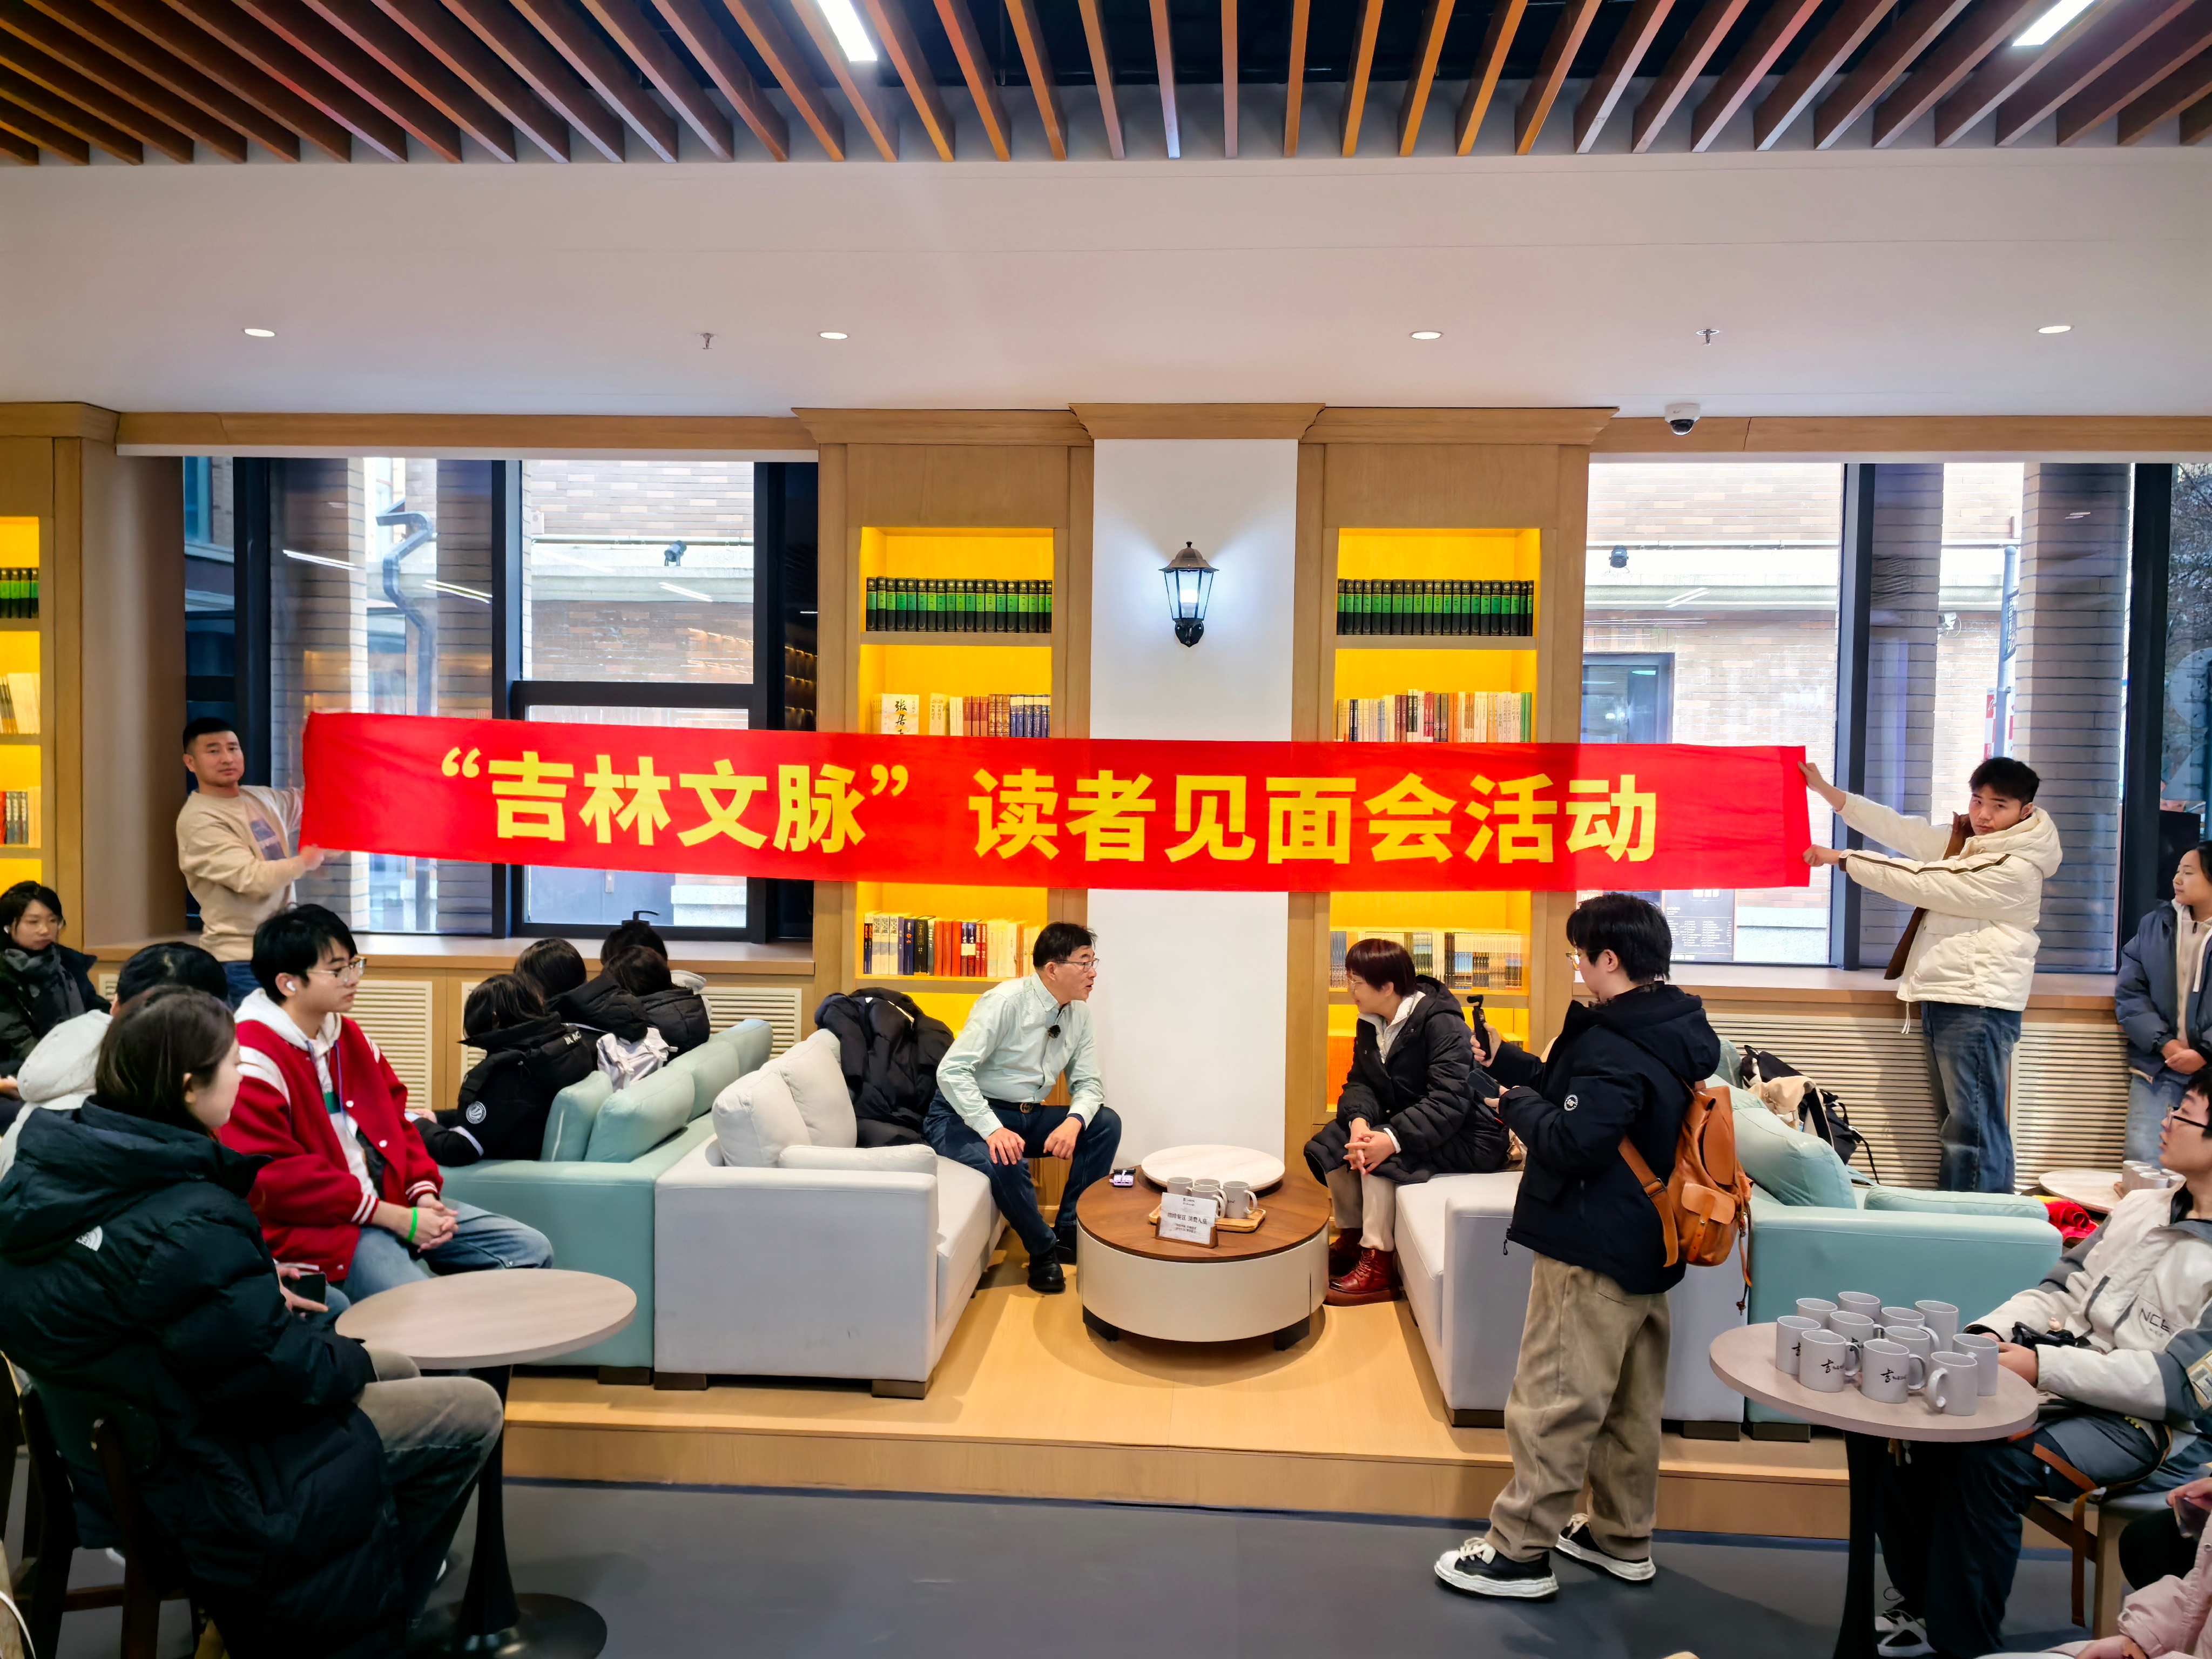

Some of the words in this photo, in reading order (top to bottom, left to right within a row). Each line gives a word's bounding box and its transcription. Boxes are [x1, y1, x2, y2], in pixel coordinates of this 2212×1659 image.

[441, 747, 908, 853] “吉林文脉”
[968, 768, 1657, 864] 读者见面会活动
